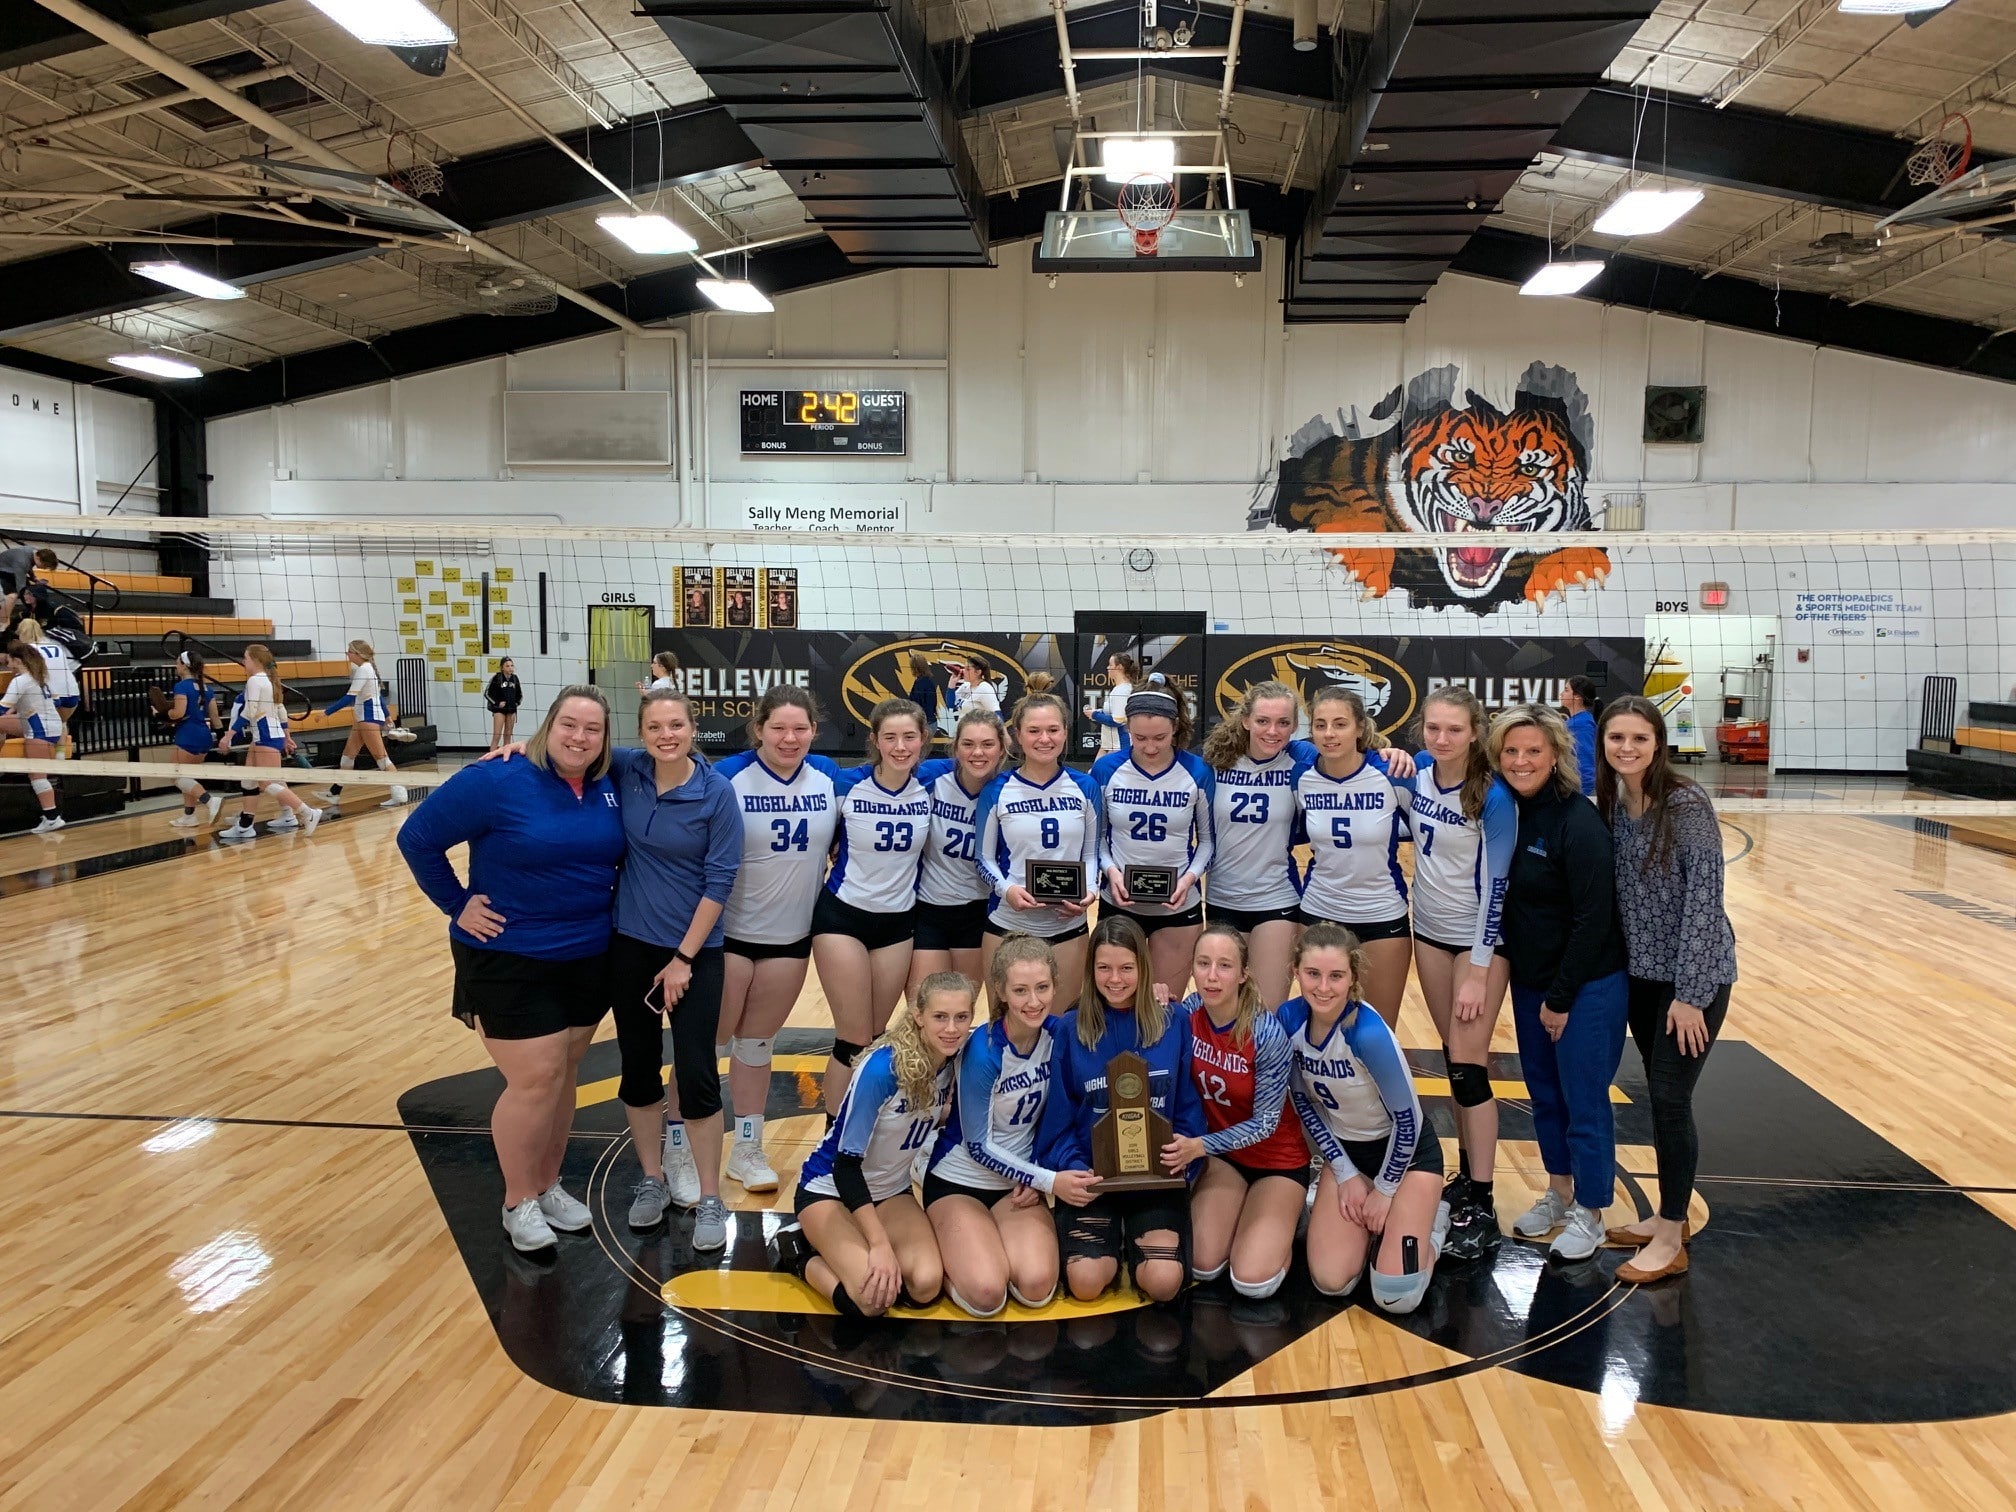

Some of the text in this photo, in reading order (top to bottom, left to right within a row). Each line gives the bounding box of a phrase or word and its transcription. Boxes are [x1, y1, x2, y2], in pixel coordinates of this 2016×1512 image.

[742, 394, 778, 406] HOME
[801, 392, 858, 423] 2:42
[862, 395, 901, 407] GUEST
[748, 506, 899, 522] Sally Meng Memorial
[753, 523, 894, 532] Teacher Coach Mentor
[685, 568, 711, 578] BELLEVUE
[726, 568, 753, 578] BELLEVUE
[769, 569, 796, 579] BELLEVUE
[601, 593, 636, 603] GIRLS
[1655, 601, 1688, 612] BOYS
[1797, 594, 1893, 602] THE ORTHOPAEDICS
[41, 646, 59, 658] 17
[697, 731, 726, 739] izabeth
[1216, 769, 1291, 786] HIGHLANDS
[603, 793, 619, 807] H
[743, 793, 827, 813] HIGHLANDS
[1005, 797, 1083, 814] HIGHLANDS
[1112, 788, 1190, 807] HIGHLANDS
[1304, 792, 1384, 811] HIGHLANDS
[852, 799, 929, 816] HIGHLANDS
[931, 798, 976, 826] HIGHLA
[1230, 792, 1270, 824] 23
[770, 819, 809, 852] 34
[1041, 818, 1060, 849] 8
[1129, 811, 1168, 842] 26
[1332, 817, 1352, 849] 5
[874, 821, 913, 852] 33
[943, 828, 976, 862] 20
[1420, 822, 1435, 857] 7
[1191, 1034, 1249, 1074] IGHLANDS
[1084, 1076, 1108, 1092] HIGHL
[1198, 1070, 1232, 1107] 12
[1009, 1090, 1042, 1125] 17
[899, 1117, 935, 1150] 10
[1383, 1107, 1416, 1184] HIGHLANDS
